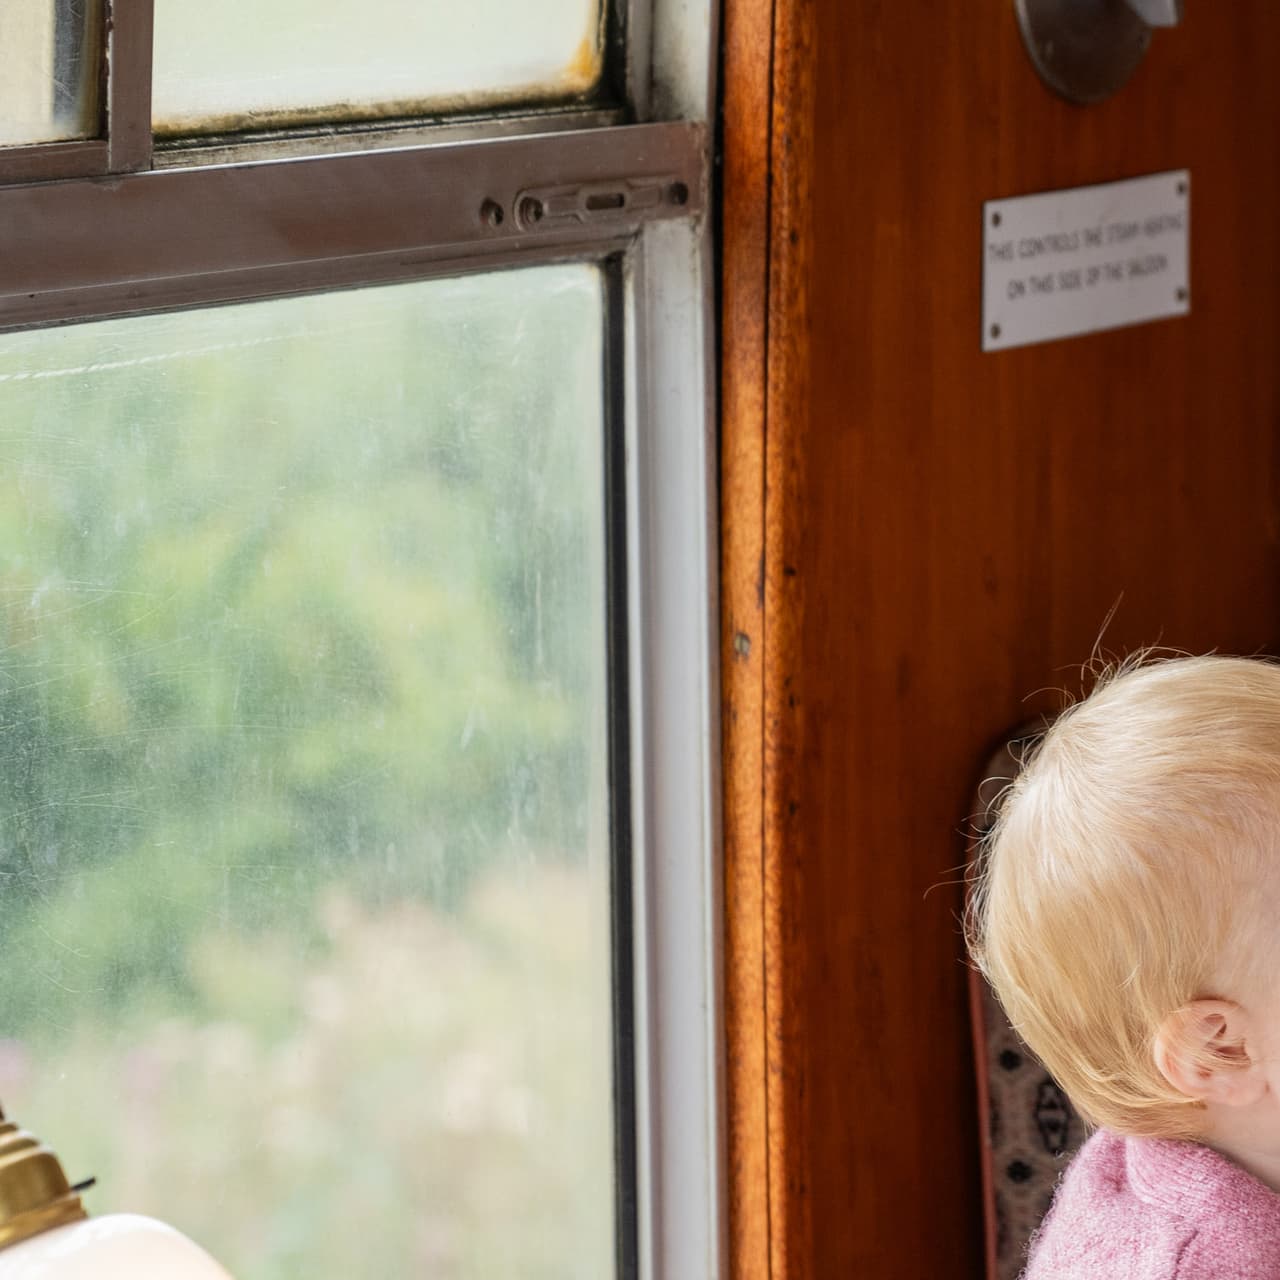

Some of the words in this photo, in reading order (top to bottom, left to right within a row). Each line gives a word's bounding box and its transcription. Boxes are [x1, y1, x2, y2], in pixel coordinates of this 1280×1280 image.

[988, 242, 1014, 261] THIS
[1018, 232, 1079, 259] CONTROLS
[1083, 225, 1103, 248] THE
[1007, 279, 1026, 301] ON
[1029, 273, 1054, 294] THIS
[1058, 269, 1082, 291] SIDE
[1085, 265, 1100, 286] OF
[1102, 261, 1123, 282] THE
